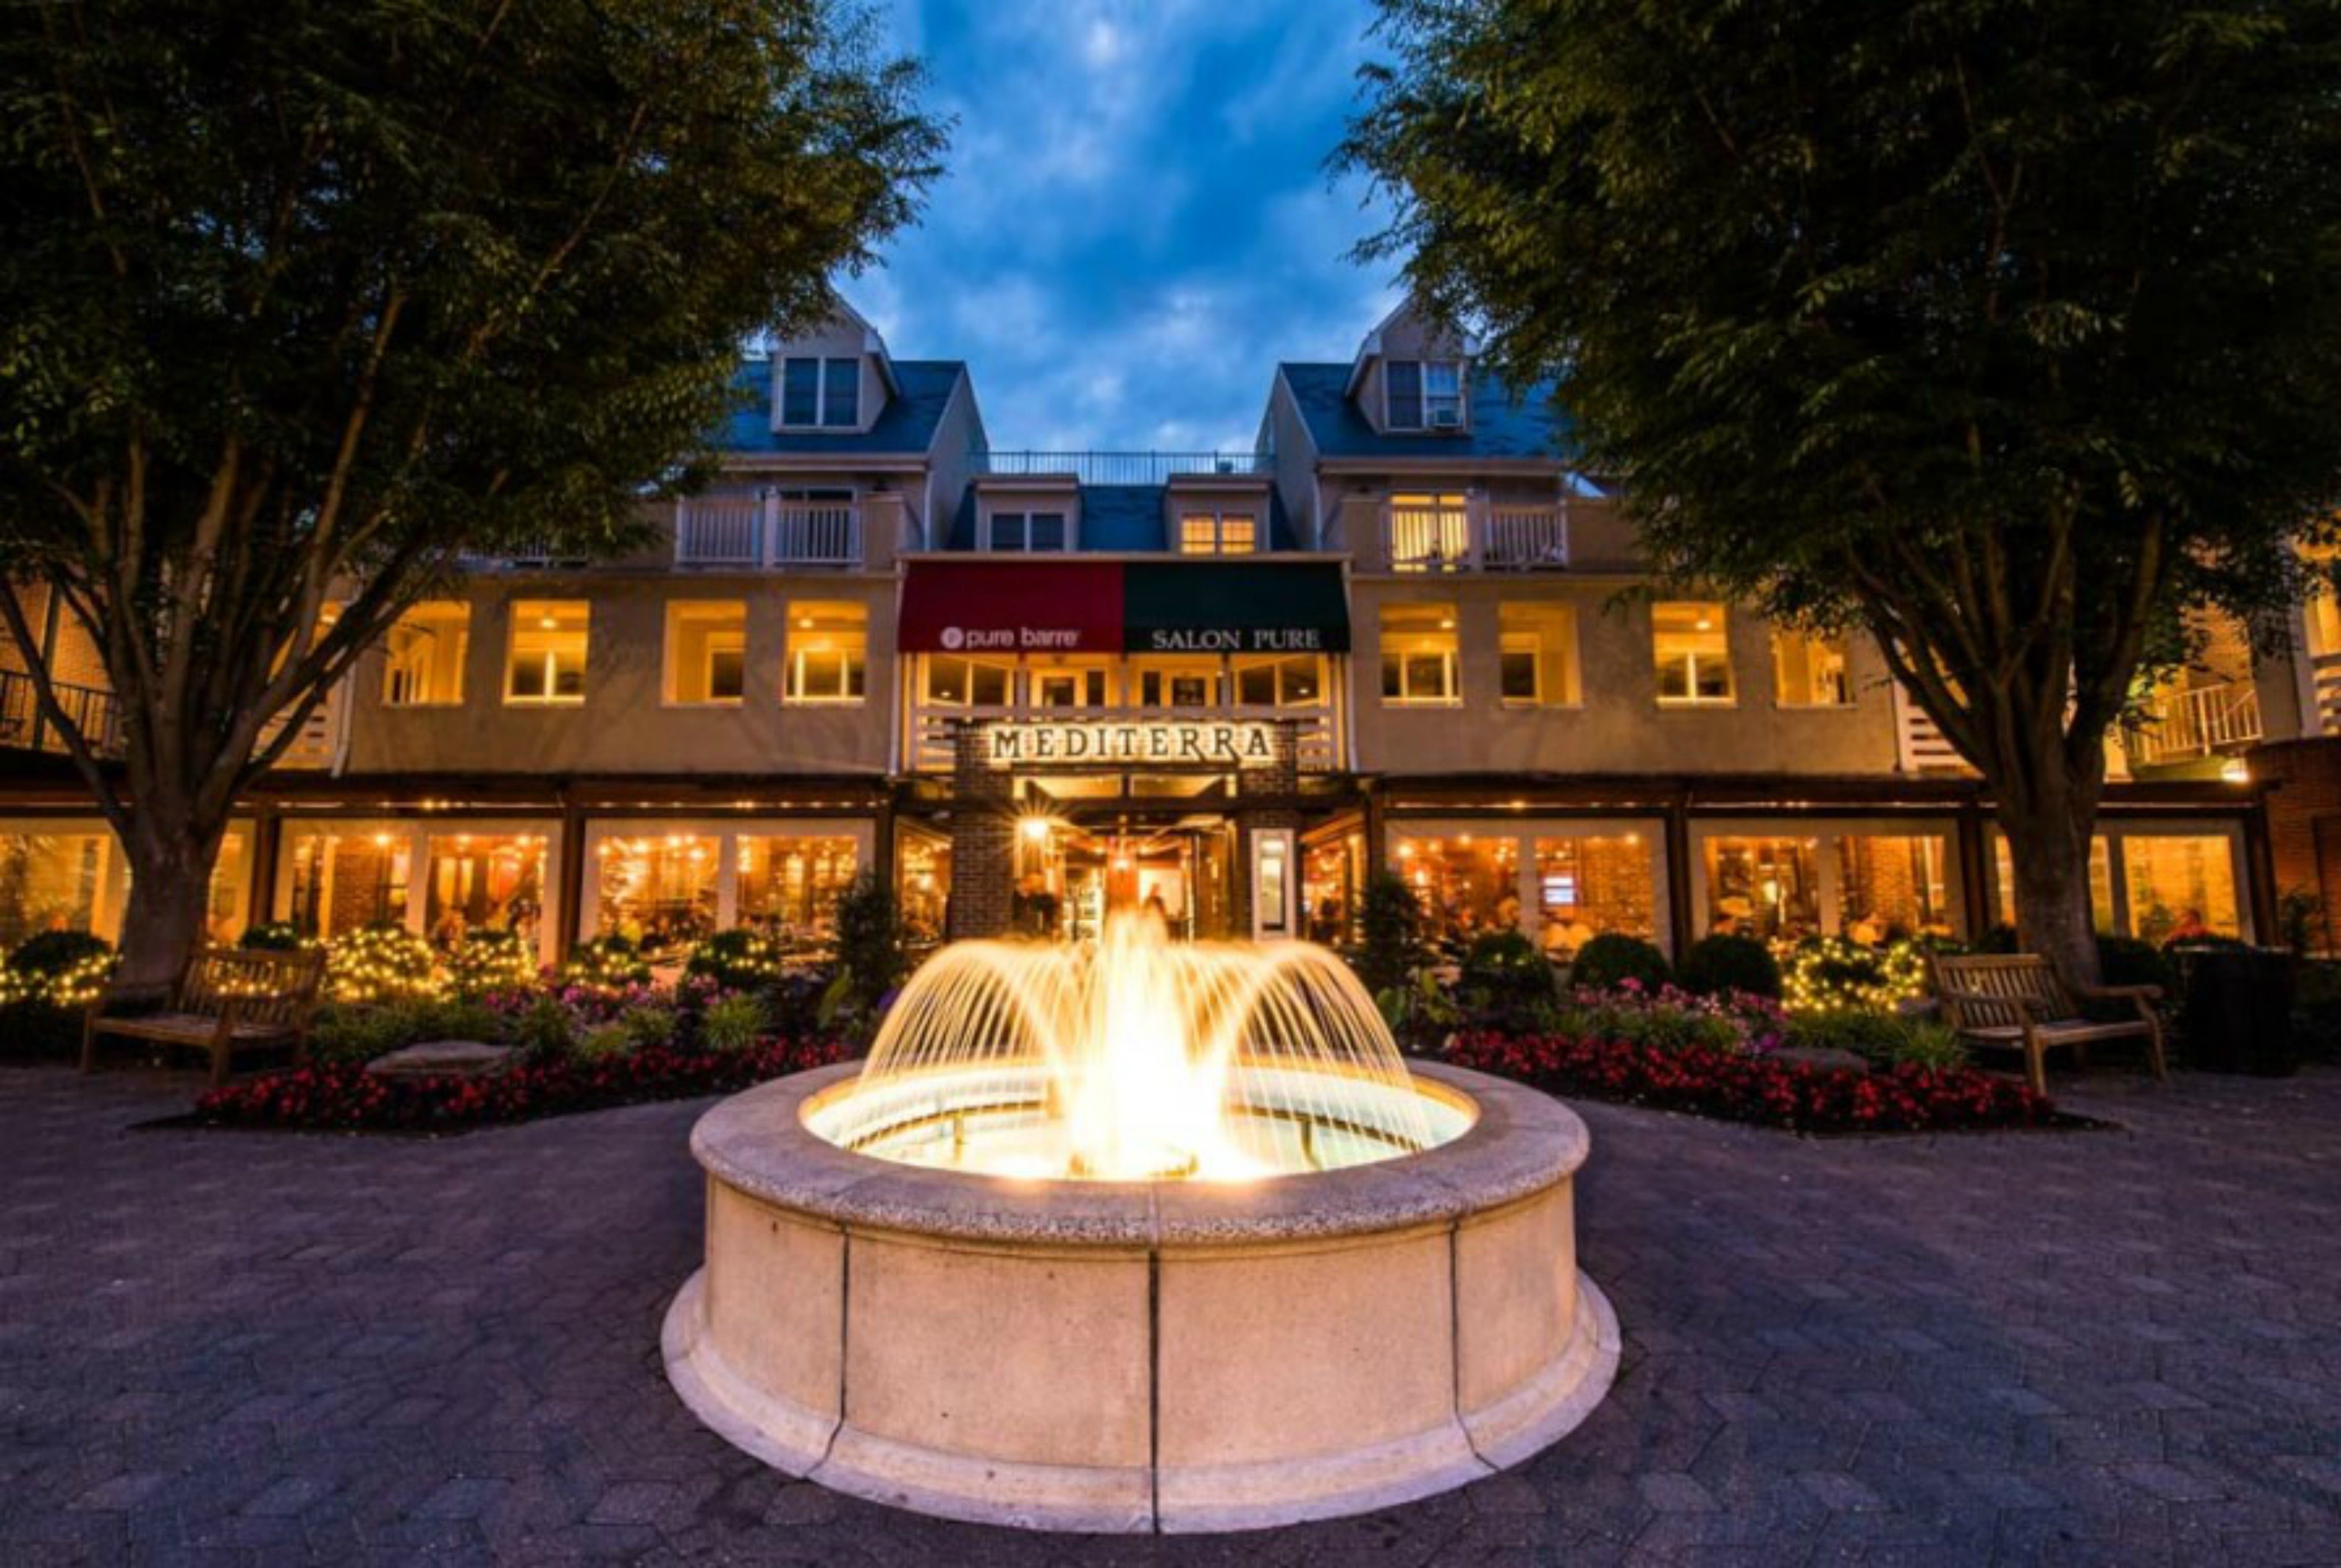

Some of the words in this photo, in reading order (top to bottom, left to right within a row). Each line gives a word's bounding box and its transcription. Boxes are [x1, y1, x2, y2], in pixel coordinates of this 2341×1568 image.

[966, 629, 1014, 649] pure
[1020, 627, 1079, 647] barre
[1152, 629, 1240, 649] SALON
[1253, 629, 1321, 649] PURE
[993, 728, 1270, 762] MEDITERRA
